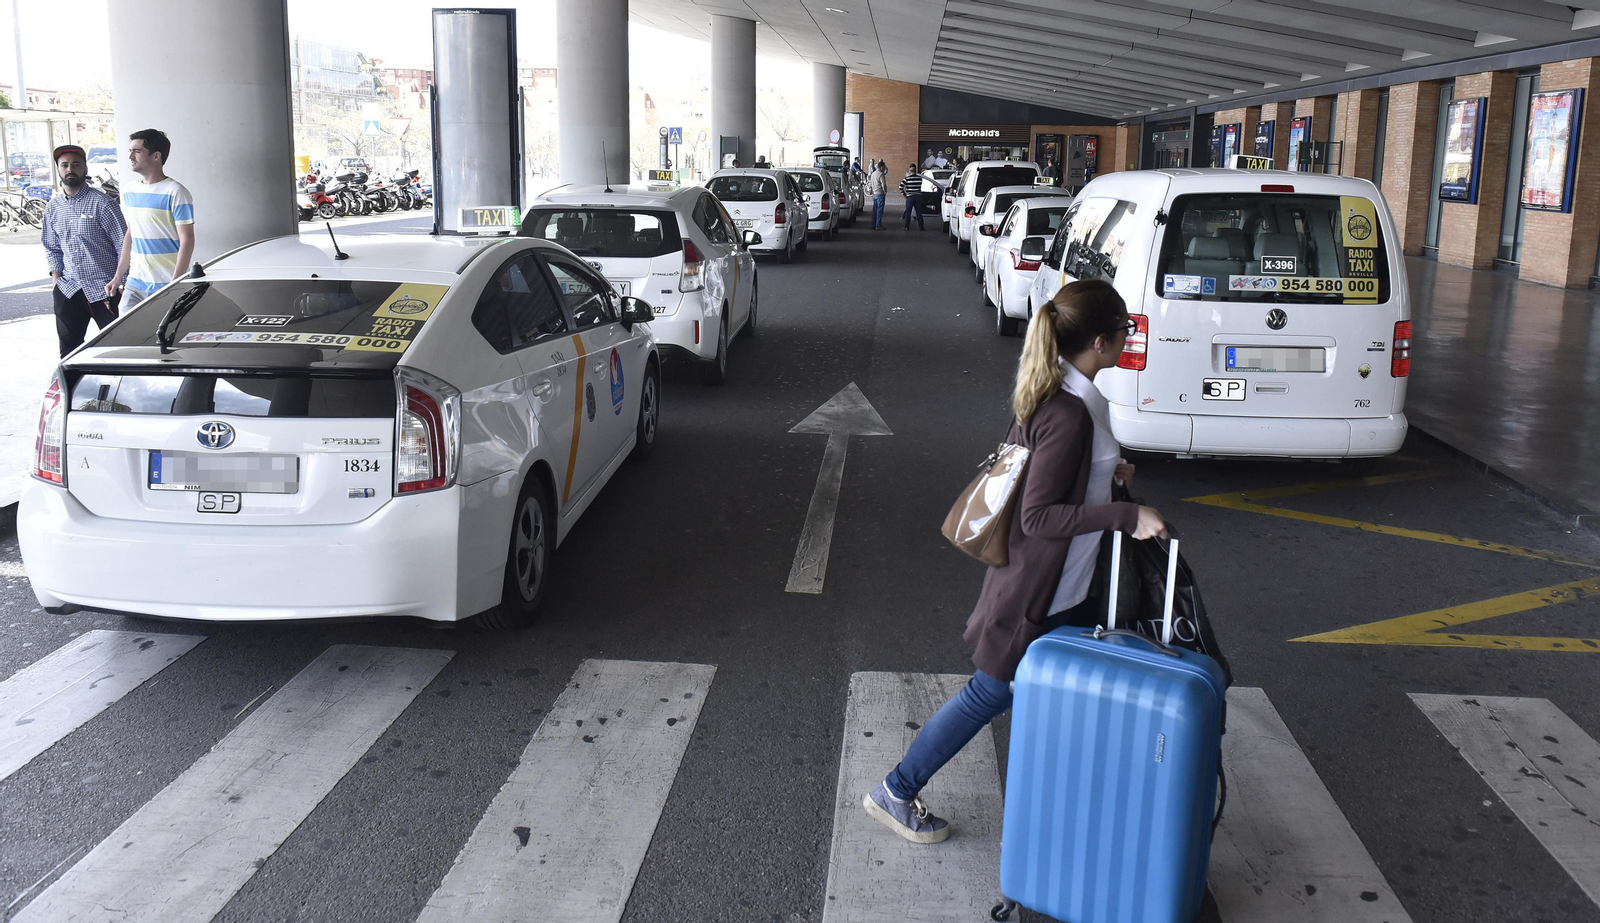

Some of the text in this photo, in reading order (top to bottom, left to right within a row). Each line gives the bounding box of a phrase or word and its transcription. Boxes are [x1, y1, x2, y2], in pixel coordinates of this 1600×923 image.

[949, 129, 1000, 137] McDonald's
[1246, 158, 1267, 169] TAXI
[655, 170, 673, 180] TAXI
[474, 209, 505, 226] TAXI
[1348, 249, 1373, 258] RADIO
[1264, 260, 1293, 270] X-396
[1348, 259, 1374, 272] TAXI
[1281, 279, 1374, 292] 954 580 000
[243, 316, 287, 325] X-122
[375, 317, 415, 327] RADIO
[372, 324, 411, 337] TAXI
[256, 333, 401, 349] 954 580 000
[1179, 393, 1187, 402] C
[1354, 399, 1371, 408] 762
[321, 437, 380, 445] PRIUS
[81, 457, 90, 468] A
[344, 459, 380, 472] 1834
